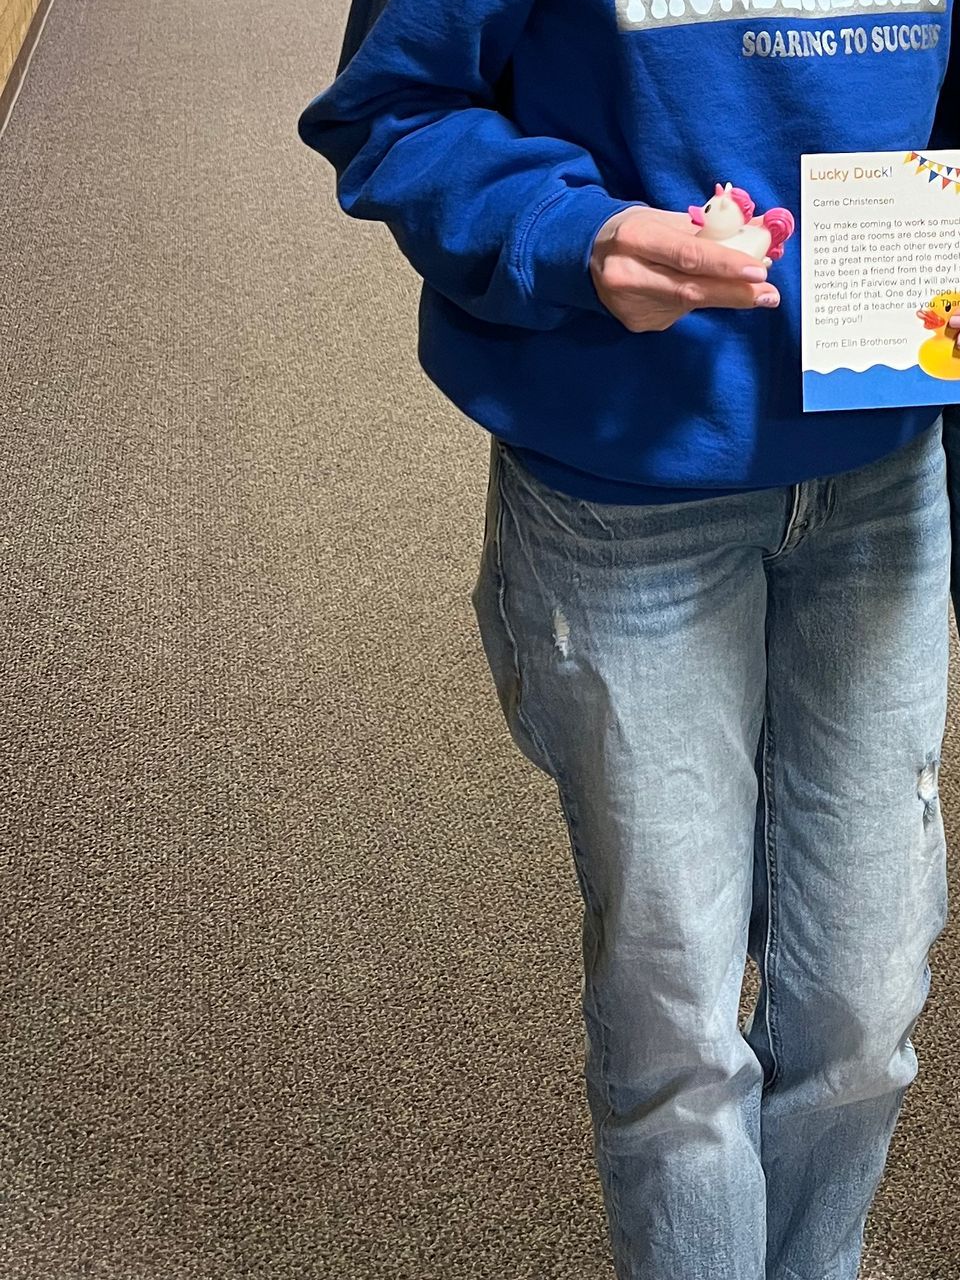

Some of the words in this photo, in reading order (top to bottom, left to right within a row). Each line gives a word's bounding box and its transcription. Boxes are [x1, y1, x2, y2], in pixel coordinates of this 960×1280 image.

[742, 30, 838, 59] SOARING
[841, 28, 868, 55] TO
[810, 168, 848, 182] Lucky
[854, 166, 893, 179] Duck!
